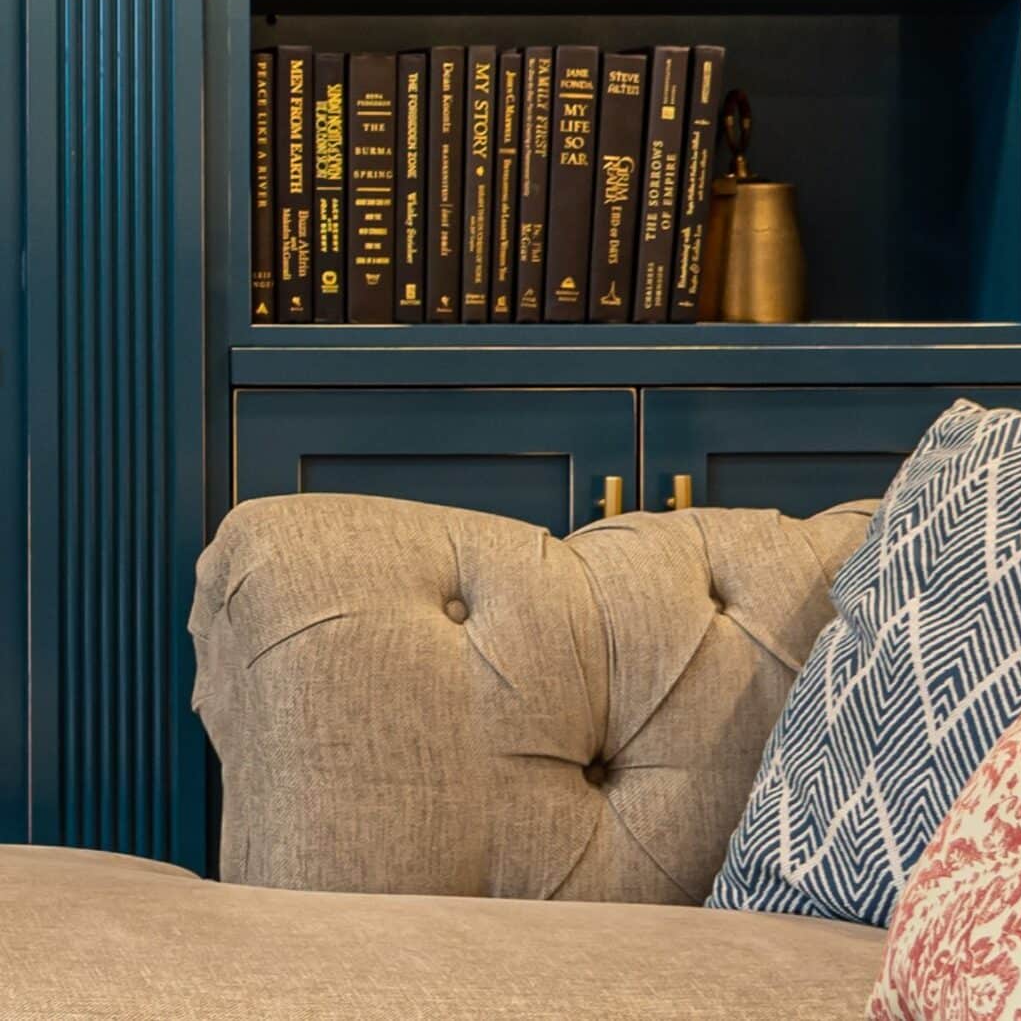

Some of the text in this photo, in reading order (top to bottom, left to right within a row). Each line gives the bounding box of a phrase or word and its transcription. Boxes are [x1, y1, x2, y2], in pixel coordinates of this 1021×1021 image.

[257, 62, 267, 106] PEACE
[560, 80, 593, 90] FONDA
[566, 68, 589, 78] JANE
[607, 83, 639, 96] ALTEN
[609, 71, 640, 83] STEVE
[442, 62, 453, 132] Dean Koontz
[472, 63, 490, 158] MY STORY
[534, 59, 552, 158] FAMILY FIRST
[564, 104, 588, 117] MY
[257, 112, 267, 145] LIKE
[290, 60, 303, 193] MEN FROM EARTH
[363, 123, 385, 132] THE
[560, 120, 591, 133] LIFE
[564, 136, 585, 149] SO
[355, 147, 392, 156] BURMA
[560, 152, 589, 166] FAR
[257, 165, 267, 208] RIVER
[353, 170, 393, 178] SPRING
[602, 155, 621, 205] REAPER
[615, 156, 635, 201] GRIM
[644, 140, 664, 241] THE SORROWS
[660, 154, 677, 231] OF EMPIRE
[298, 210, 310, 277] Buzz Aldrin
[520, 223, 531, 261] McGraw
[531, 224, 542, 262] Dr. Phil
